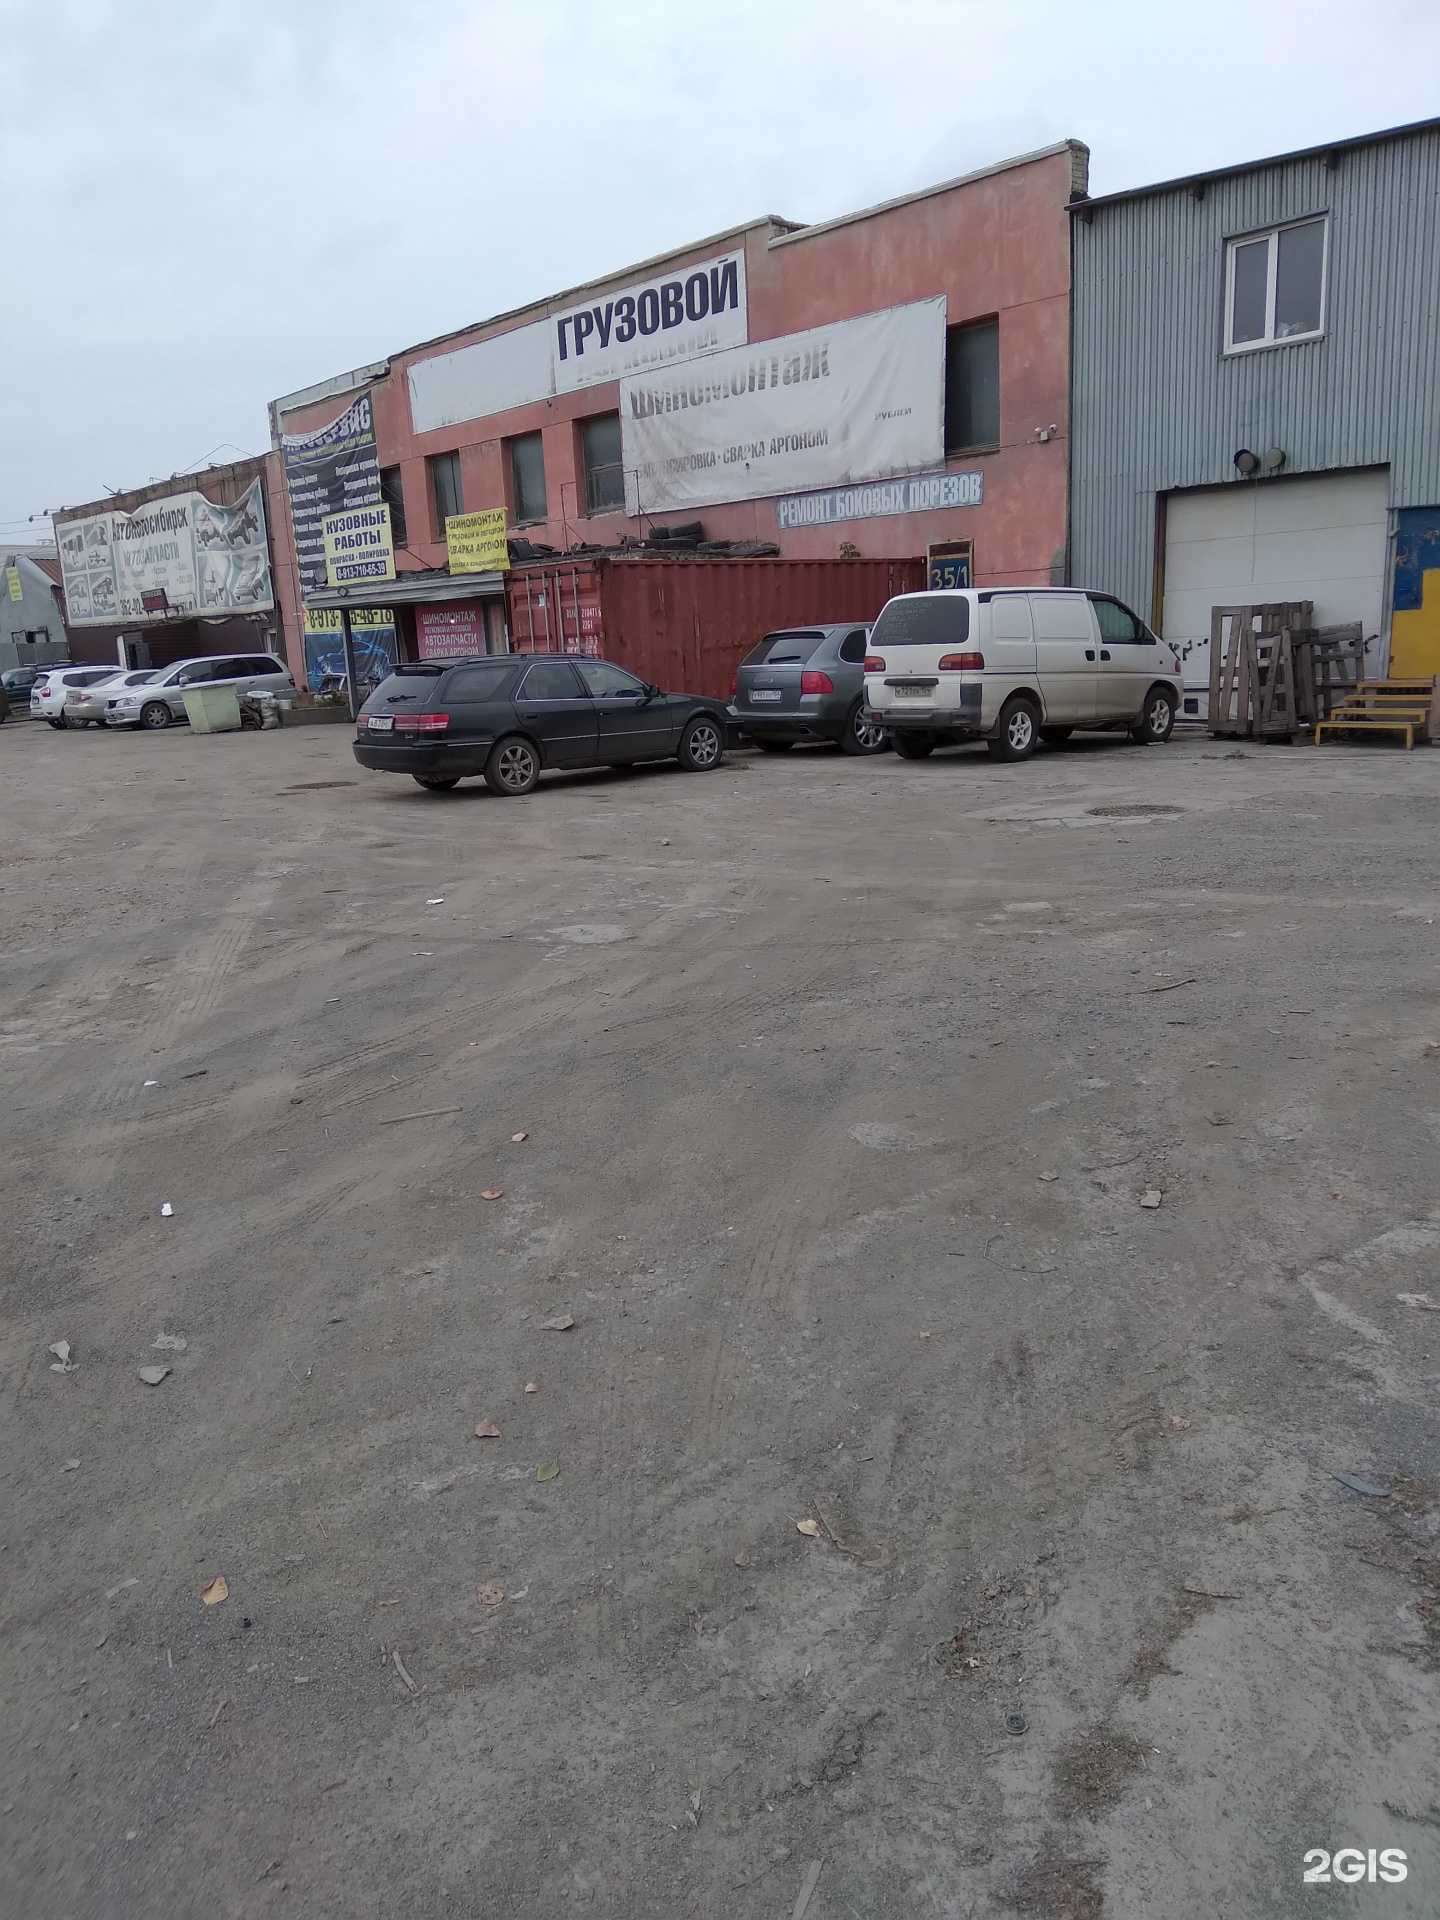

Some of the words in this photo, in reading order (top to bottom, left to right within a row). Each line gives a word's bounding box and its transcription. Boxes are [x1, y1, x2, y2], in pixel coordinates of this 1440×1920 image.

[557, 259, 738, 361] ГРУЗОВОЙ
[769, 429, 829, 455] АРГОНОМ
[780, 495, 832, 525] РЕМОНТ
[836, 483, 905, 517] БОКОВЫХ
[909, 473, 982, 509] ПОРЕЗОВ
[326, 510, 386, 534] КУЗОВНЫЕ
[334, 530, 381, 551] РАБОТЫ
[931, 566, 968, 589] 35/1
[422, 610, 476, 624] ШИНОМОНТАЖ
[425, 633, 477, 646] АВТОЗАПЧАСТИ
